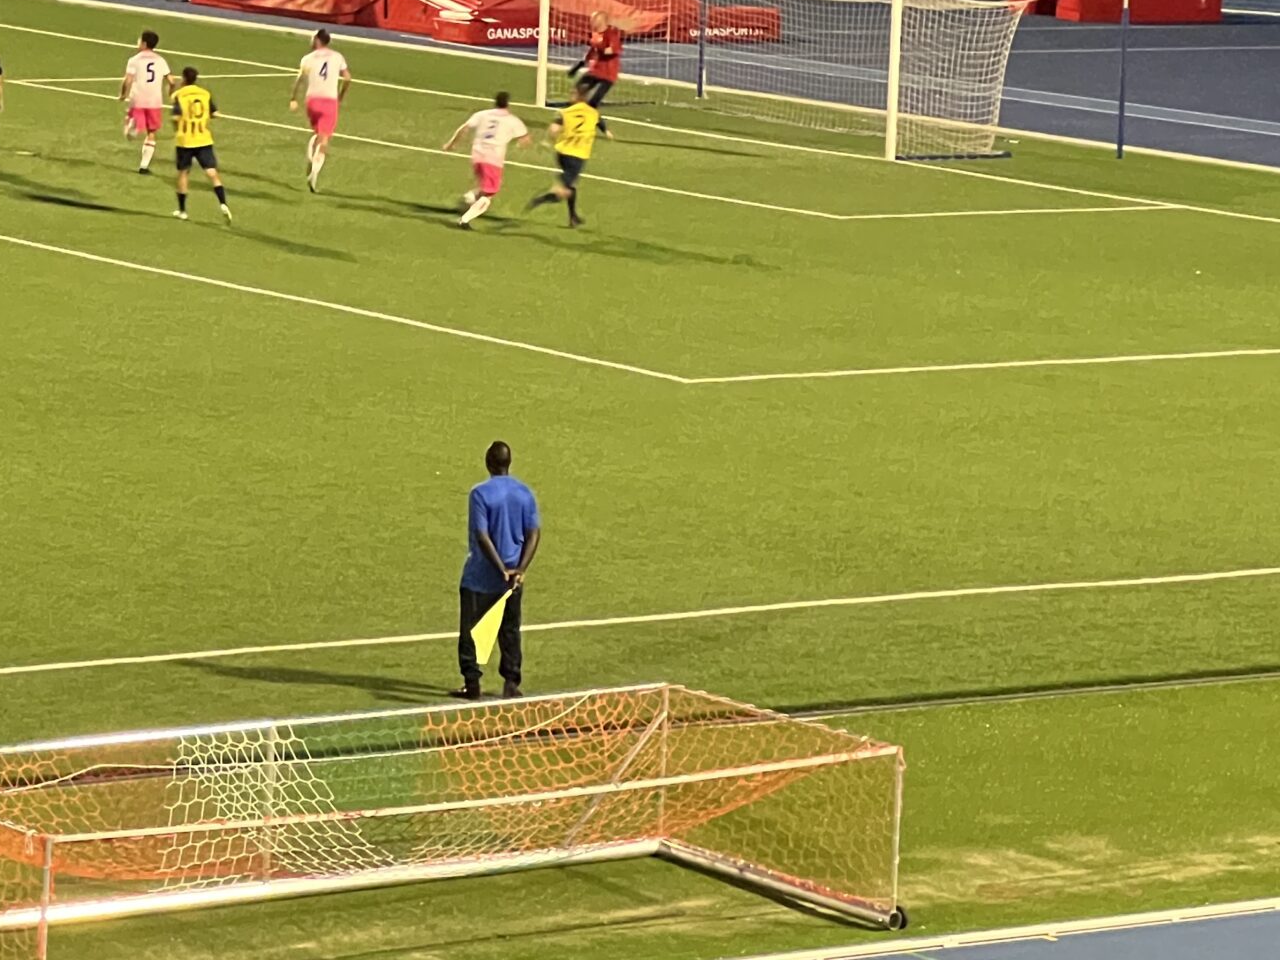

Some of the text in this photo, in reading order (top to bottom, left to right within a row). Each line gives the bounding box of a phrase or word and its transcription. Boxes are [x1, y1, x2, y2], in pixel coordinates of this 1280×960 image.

[146, 62, 155, 82] 5
[319, 61, 328, 81] 4
[188, 99, 204, 119] 10
[574, 115, 585, 134] 2
